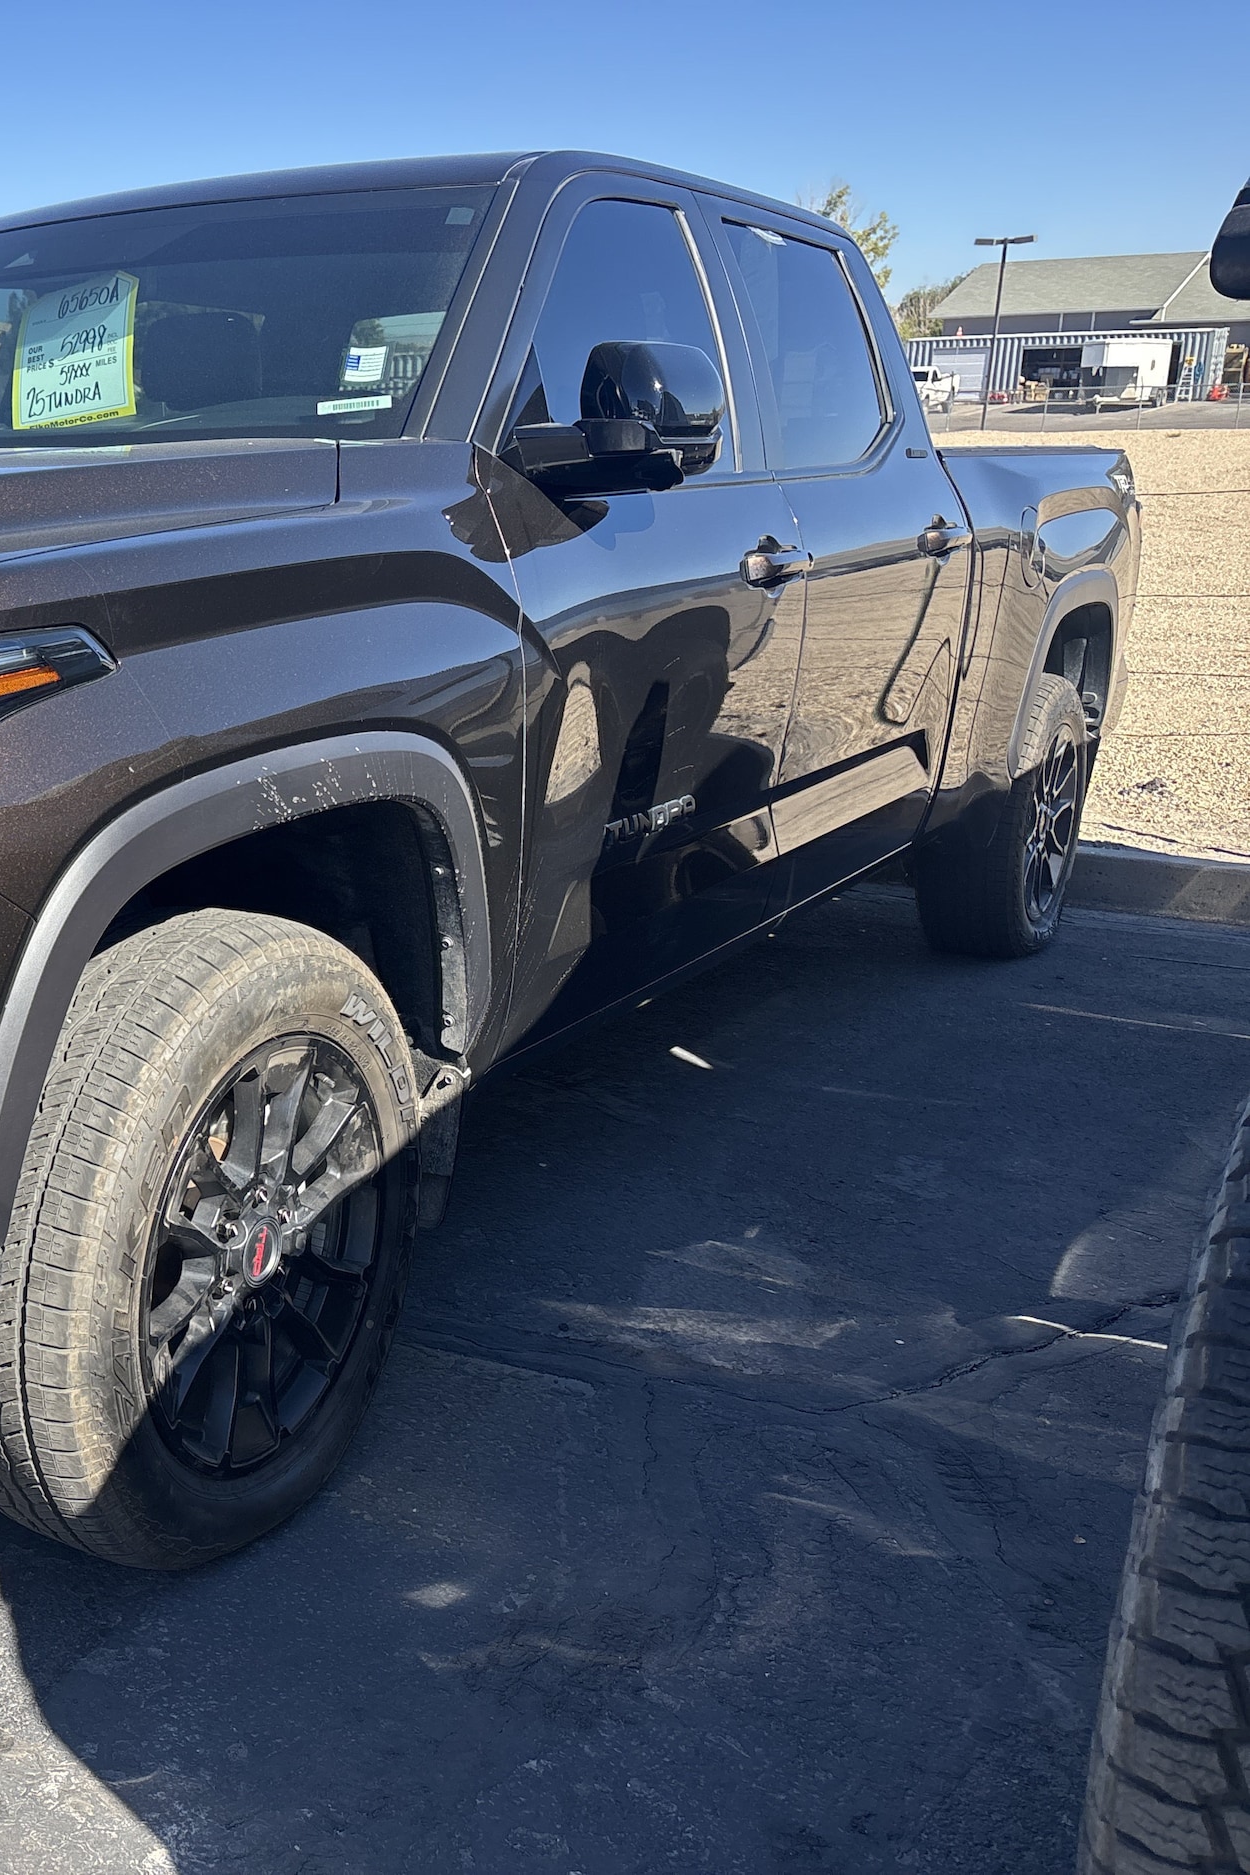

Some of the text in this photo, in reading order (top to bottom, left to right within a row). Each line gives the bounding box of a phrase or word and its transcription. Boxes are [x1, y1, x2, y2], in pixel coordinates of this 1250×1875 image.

[58, 277, 119, 319] 65650A
[57, 324, 107, 361] 52998
[28, 345, 43, 354] OUR
[27, 354, 45, 364] BEST
[95, 355, 118, 367] MILES
[26, 361, 47, 373] PRICE
[603, 794, 696, 840] TUNDRA
